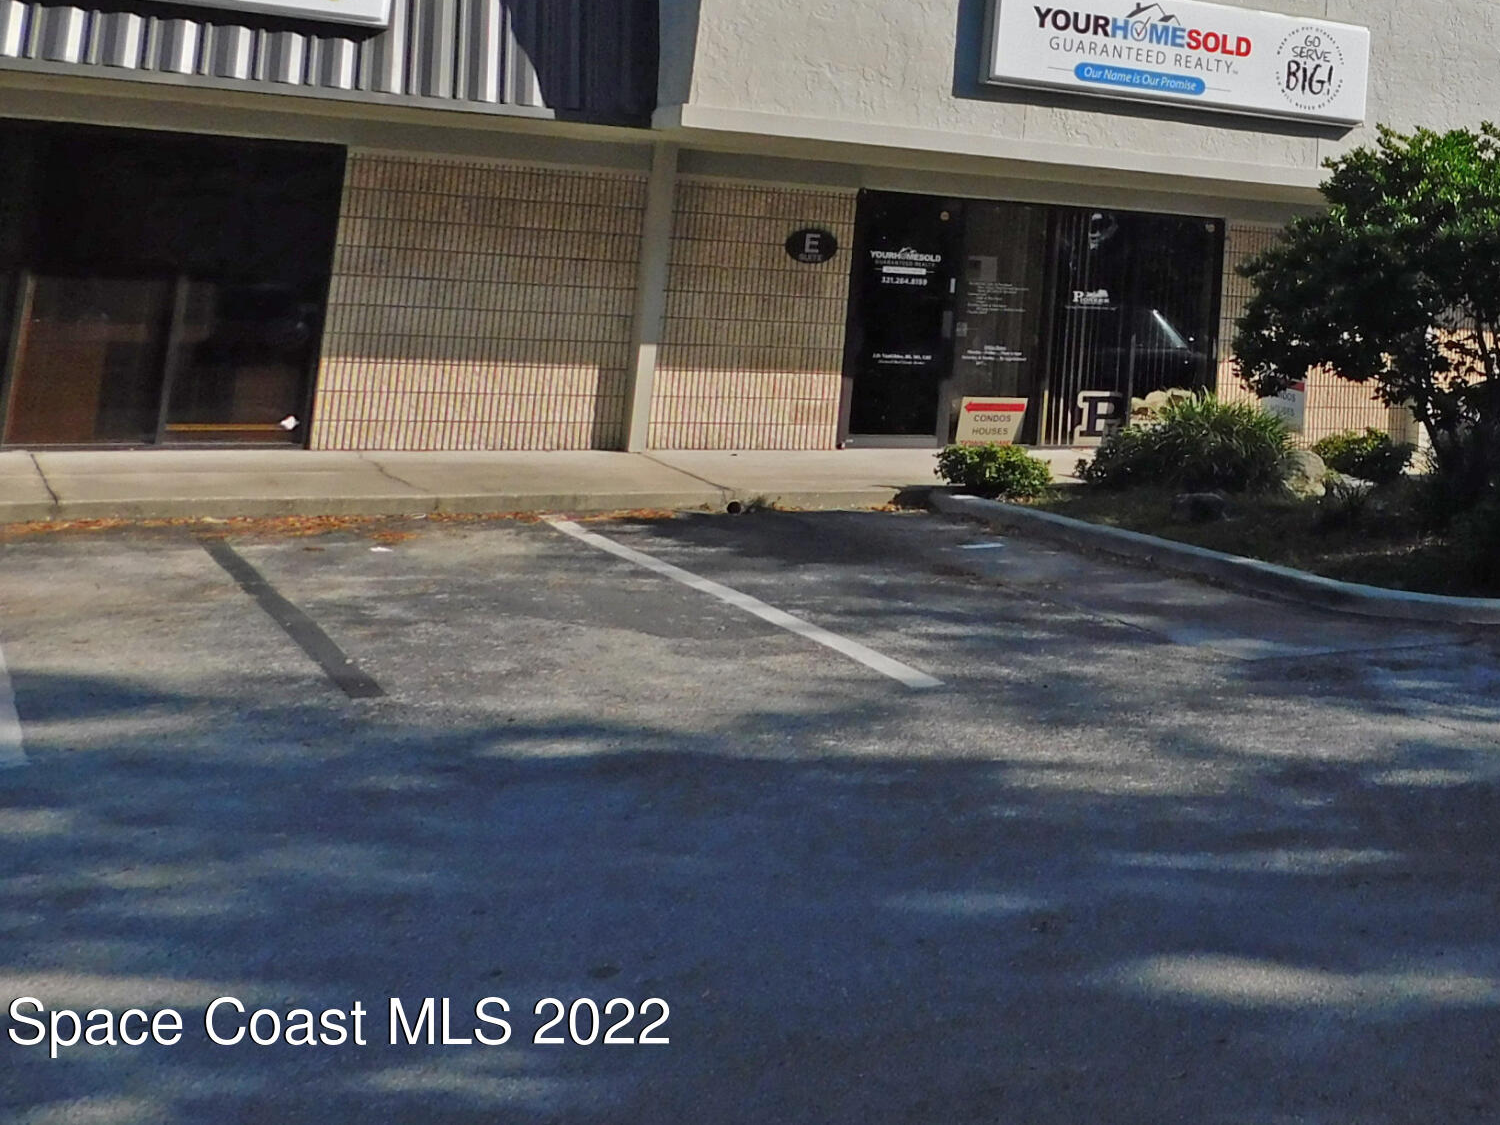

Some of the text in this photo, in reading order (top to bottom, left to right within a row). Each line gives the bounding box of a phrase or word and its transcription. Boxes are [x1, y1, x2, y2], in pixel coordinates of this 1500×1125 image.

[1304, 35, 1321, 48] GO
[1049, 36, 1234, 74] GUARANTEED REALTY
[1291, 45, 1332, 63] SERVE
[1084, 66, 1198, 91] Our Name is Our Promise
[805, 233, 820, 253] E
[974, 414, 1011, 423] CONDOS
[972, 427, 1009, 436] HOUSES
